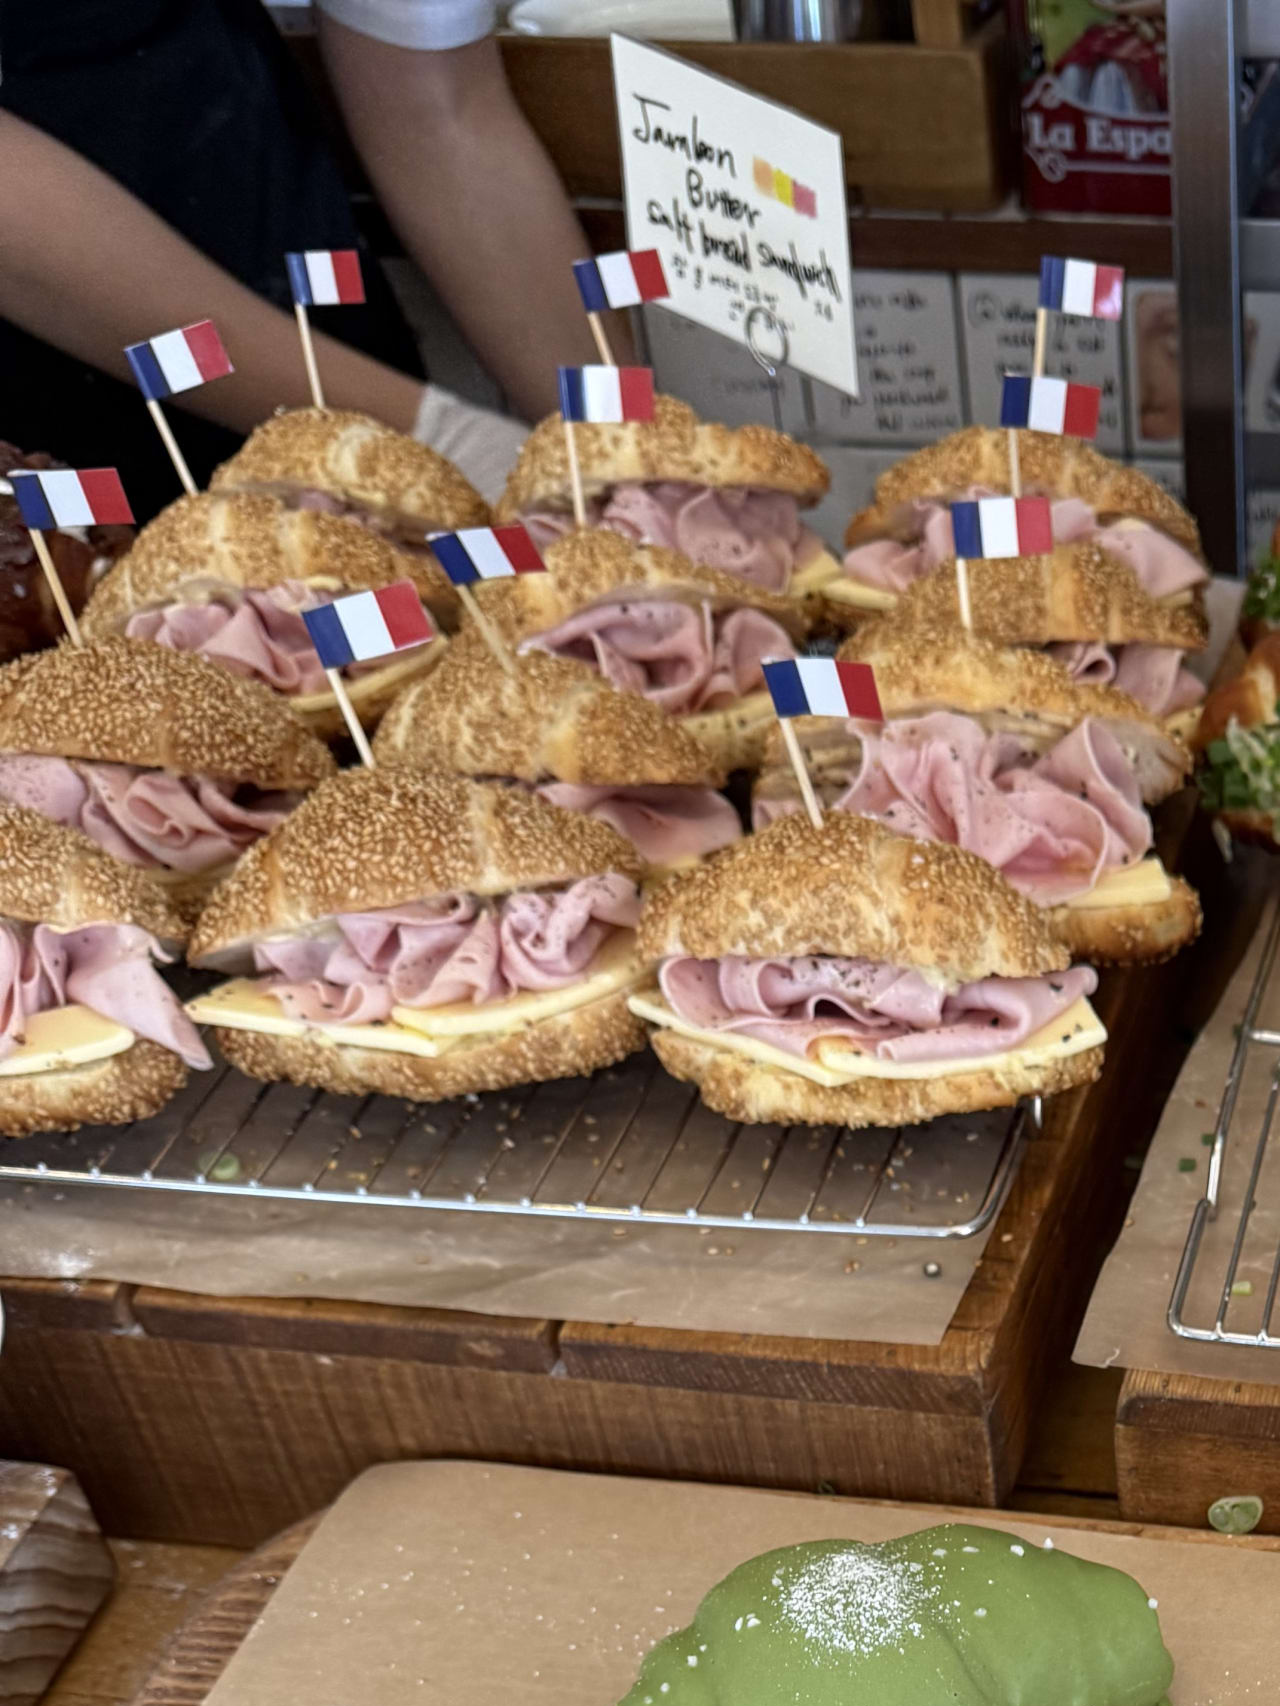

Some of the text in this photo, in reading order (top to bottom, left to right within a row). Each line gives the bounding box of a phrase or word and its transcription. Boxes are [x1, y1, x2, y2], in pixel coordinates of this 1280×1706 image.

[632, 92, 736, 178] Jambon
[1028, 112, 1076, 150] La
[686, 167, 761, 229] Butter
